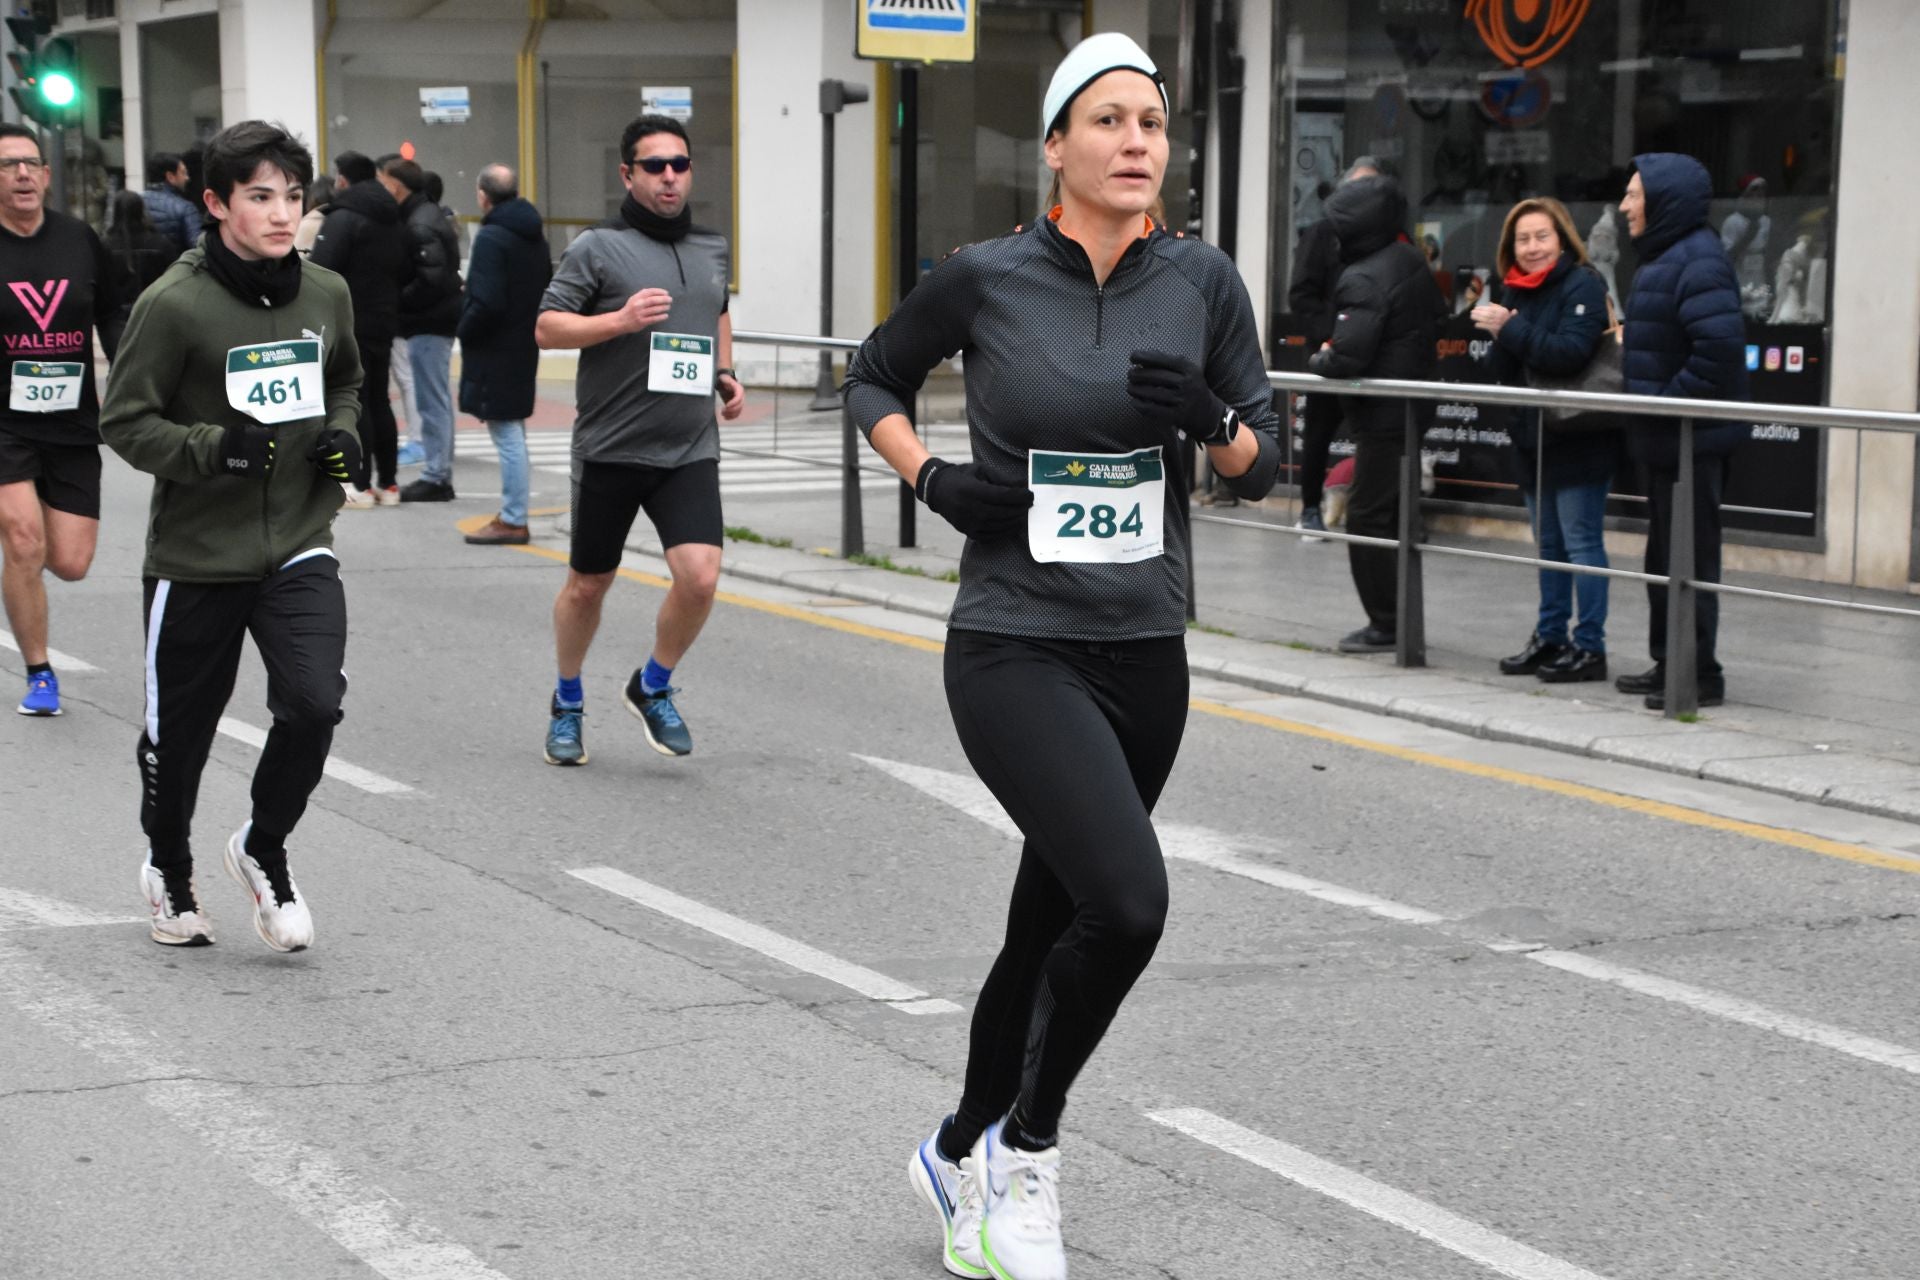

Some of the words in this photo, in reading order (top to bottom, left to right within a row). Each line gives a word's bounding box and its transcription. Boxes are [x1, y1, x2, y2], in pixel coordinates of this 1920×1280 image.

[4, 331, 84, 349] VALERIO
[672, 362, 698, 380] 58
[26, 384, 67, 401] 307
[247, 377, 302, 406] 461
[1751, 423, 1799, 441] auditiva
[1088, 471, 1102, 479] DE
[1103, 470, 1137, 480] NAVARRA
[1089, 463, 1110, 472] CAJA
[1111, 463, 1136, 472] RURAL
[1057, 502, 1143, 538] 284
